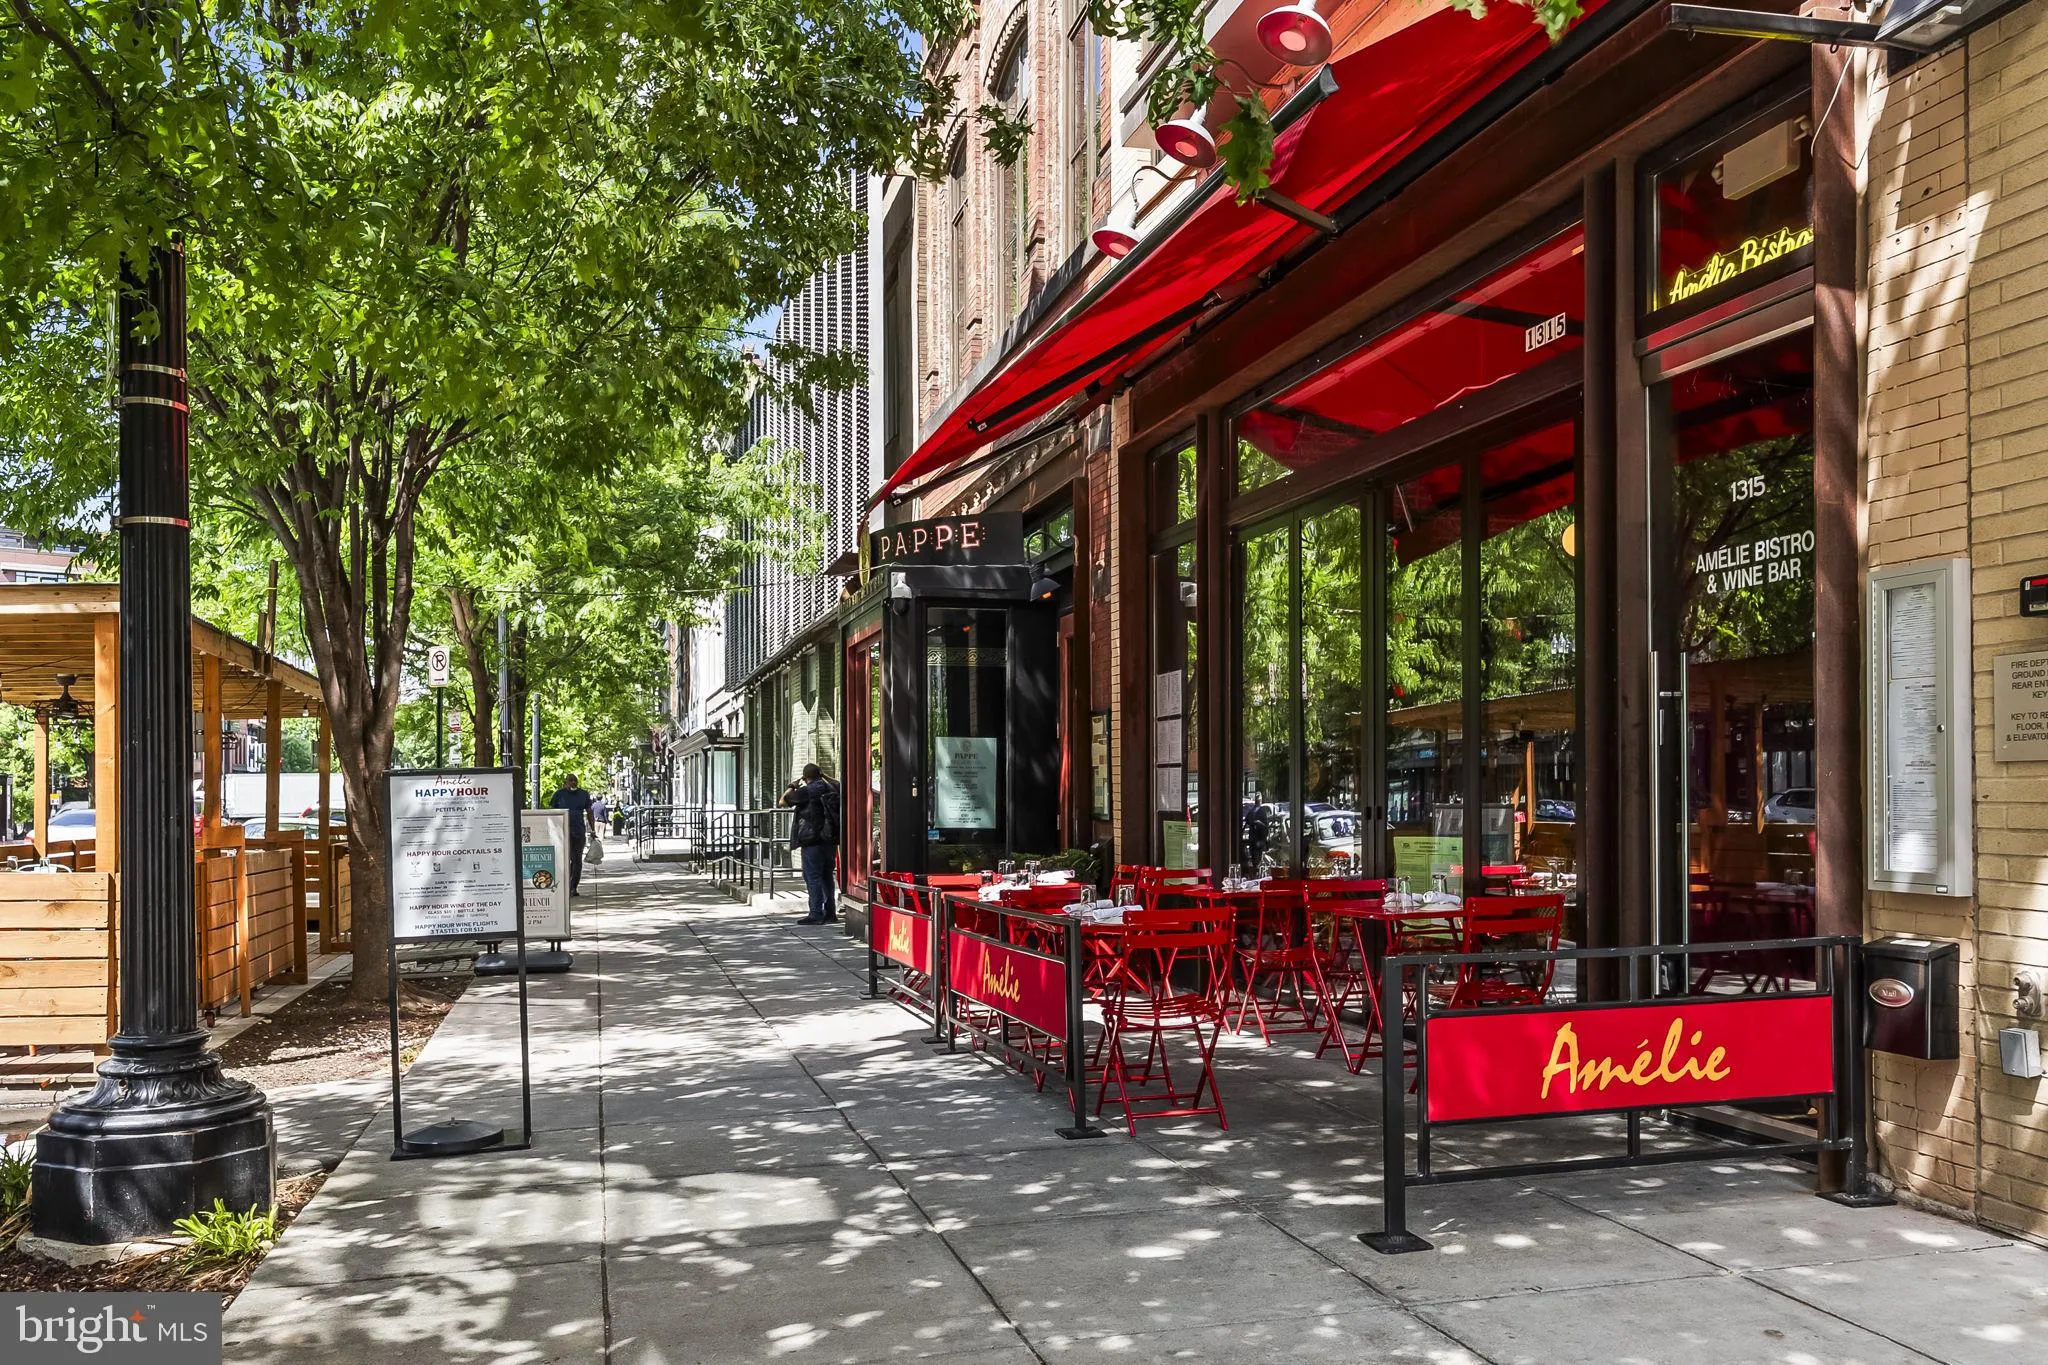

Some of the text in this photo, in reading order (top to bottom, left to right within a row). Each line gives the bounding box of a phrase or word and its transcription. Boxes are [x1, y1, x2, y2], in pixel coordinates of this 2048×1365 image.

[1527, 314, 1565, 350] 1315
[1730, 475, 1766, 502] 1315
[1695, 529, 1815, 574] AMÉLIE BISTRO
[1706, 558, 1801, 594] & WINE BAR
[2011, 660, 2028, 669] FIRE
[2011, 669, 2046, 679] GROUND
[2011, 681, 2033, 690] REAR
[2032, 690, 2048, 698] KEY
[2010, 712, 2026, 720] KEY
[2013, 732, 2048, 741] ELEVATO
[529, 897, 550, 906] LUNCH
[889, 915, 911, 955] Amélie
[983, 948, 1021, 1003] Amélie
[1541, 1017, 1731, 1100] Amélie
